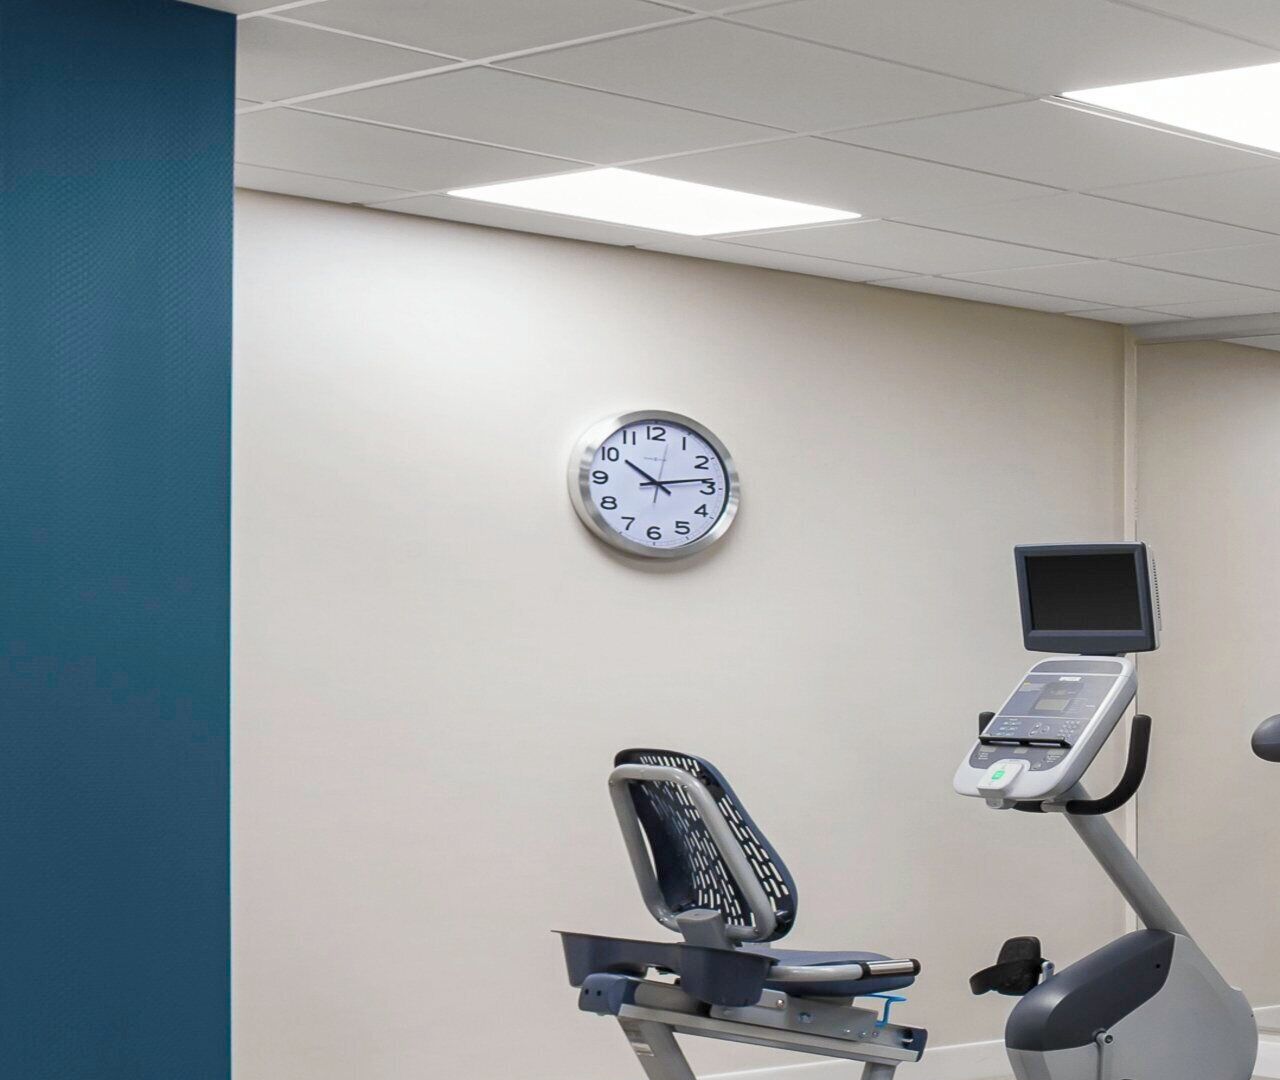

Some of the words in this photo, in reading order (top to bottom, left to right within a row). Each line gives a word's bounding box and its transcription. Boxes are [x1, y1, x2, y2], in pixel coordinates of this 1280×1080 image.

[622, 429, 637, 445] 11
[646, 425, 667, 442] 12
[682, 436, 687, 451] 1
[601, 446, 620, 462] 10
[694, 455, 710, 470] 2
[592, 471, 609, 485] 9
[700, 480, 716, 496] 3
[600, 496, 618, 510] 8
[694, 504, 709, 518] 4
[621, 516, 636, 531] 7
[675, 521, 691, 535] 5
[646, 526, 662, 541] 6
